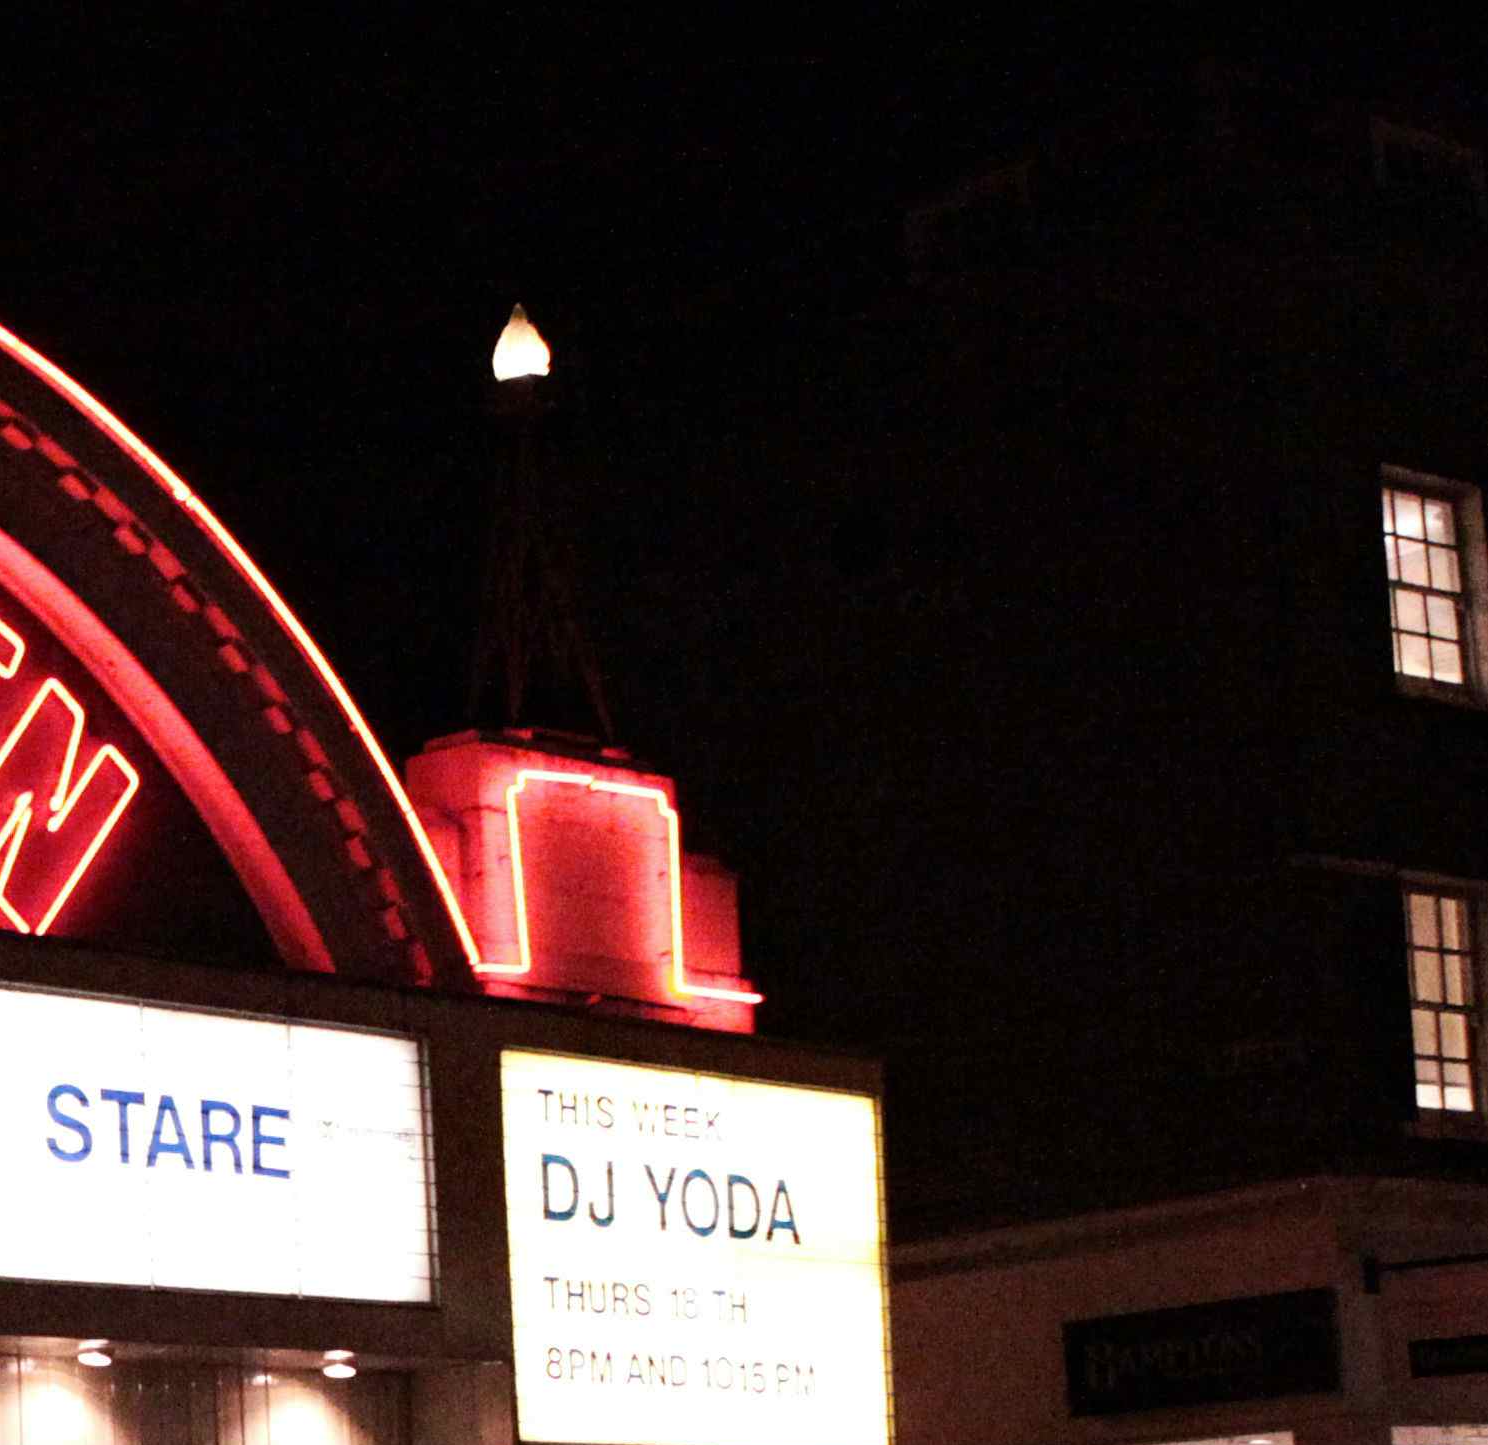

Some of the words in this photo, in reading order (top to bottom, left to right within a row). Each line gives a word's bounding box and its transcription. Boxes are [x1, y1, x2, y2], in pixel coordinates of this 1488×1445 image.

[537, 1089, 615, 1129] THIS
[46, 1083, 291, 1180] STARE
[541, 1153, 615, 1228] DJ
[643, 1164, 802, 1246] YODA
[542, 1276, 651, 1316] THURS
[627, 1354, 687, 1387] AND
